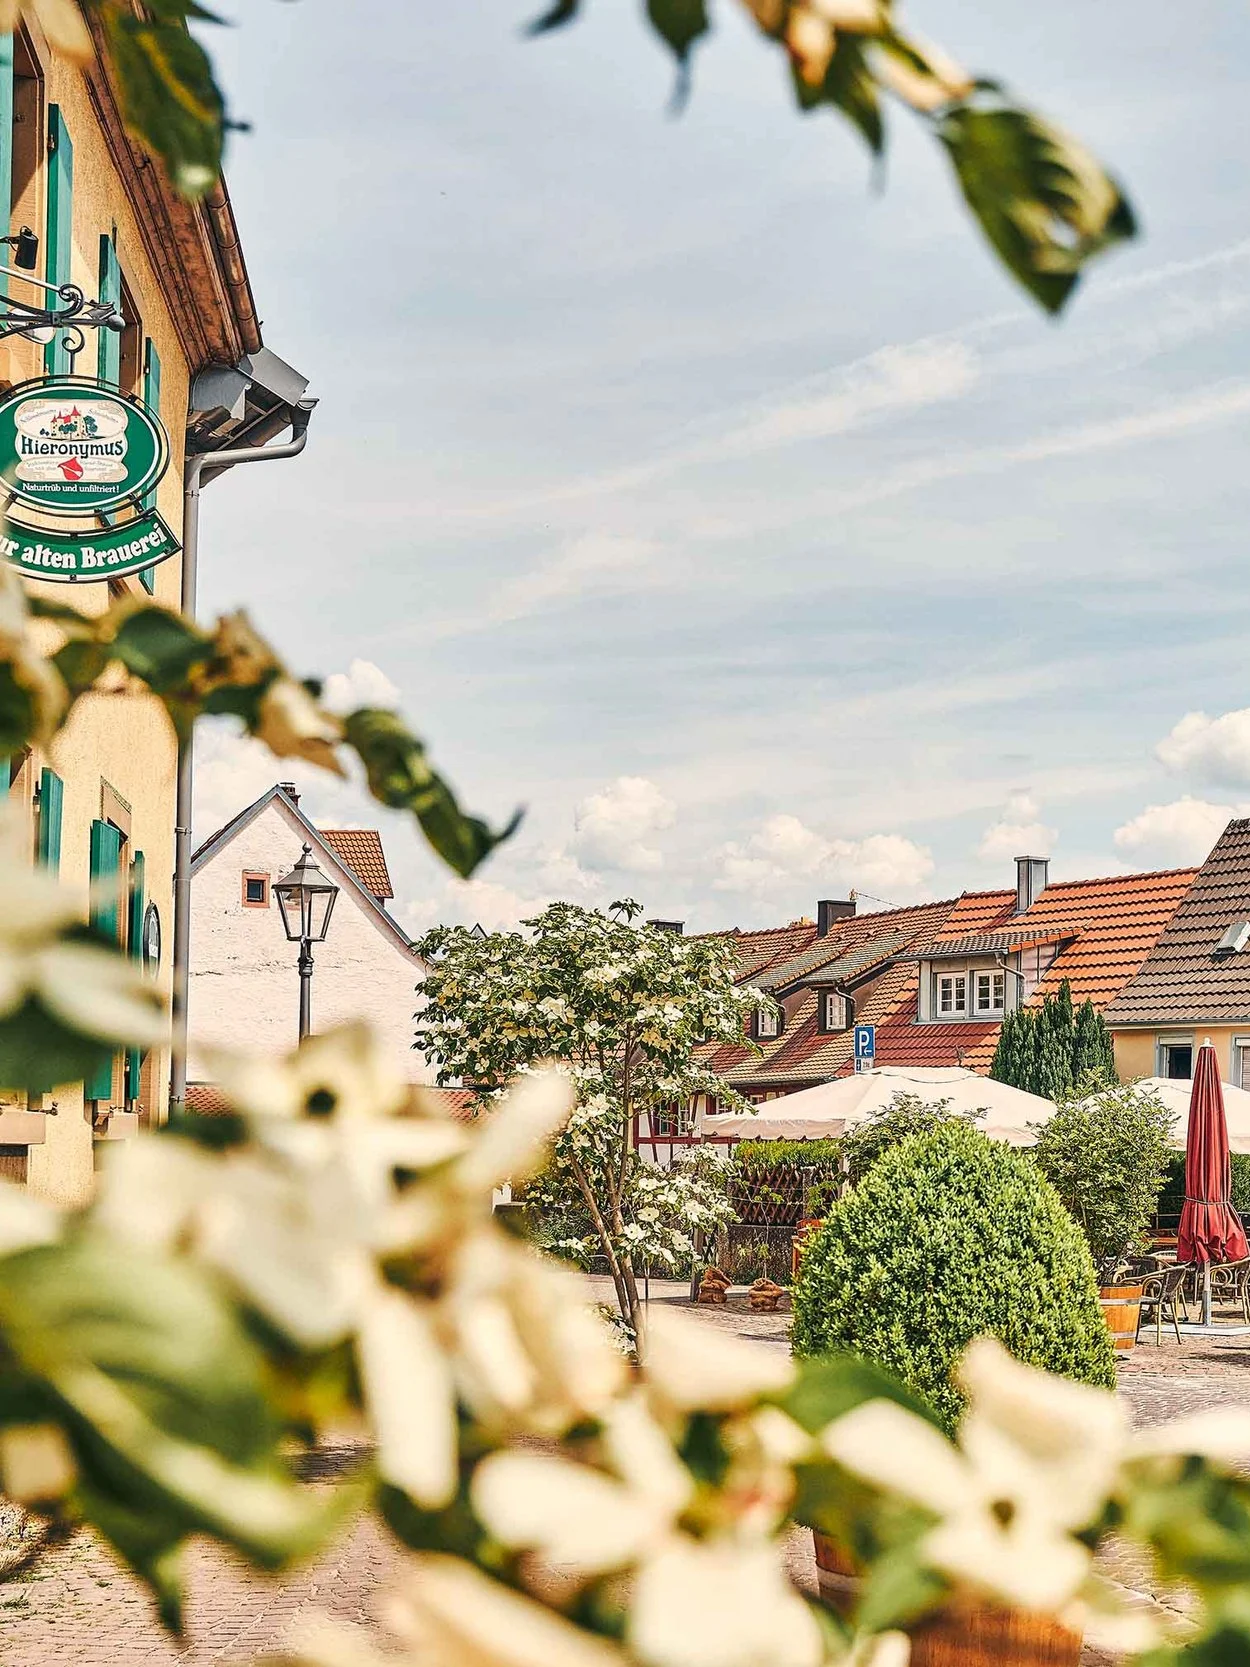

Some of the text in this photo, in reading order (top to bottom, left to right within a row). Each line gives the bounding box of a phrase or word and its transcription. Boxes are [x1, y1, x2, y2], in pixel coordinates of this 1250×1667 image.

[21, 435, 124, 459] Hieronymus
[22, 483, 120, 494] Naturtrüb und unfiltriert!
[21, 543, 77, 569] alten
[80, 523, 168, 569] Brauerei
[859, 1030, 870, 1056] P
